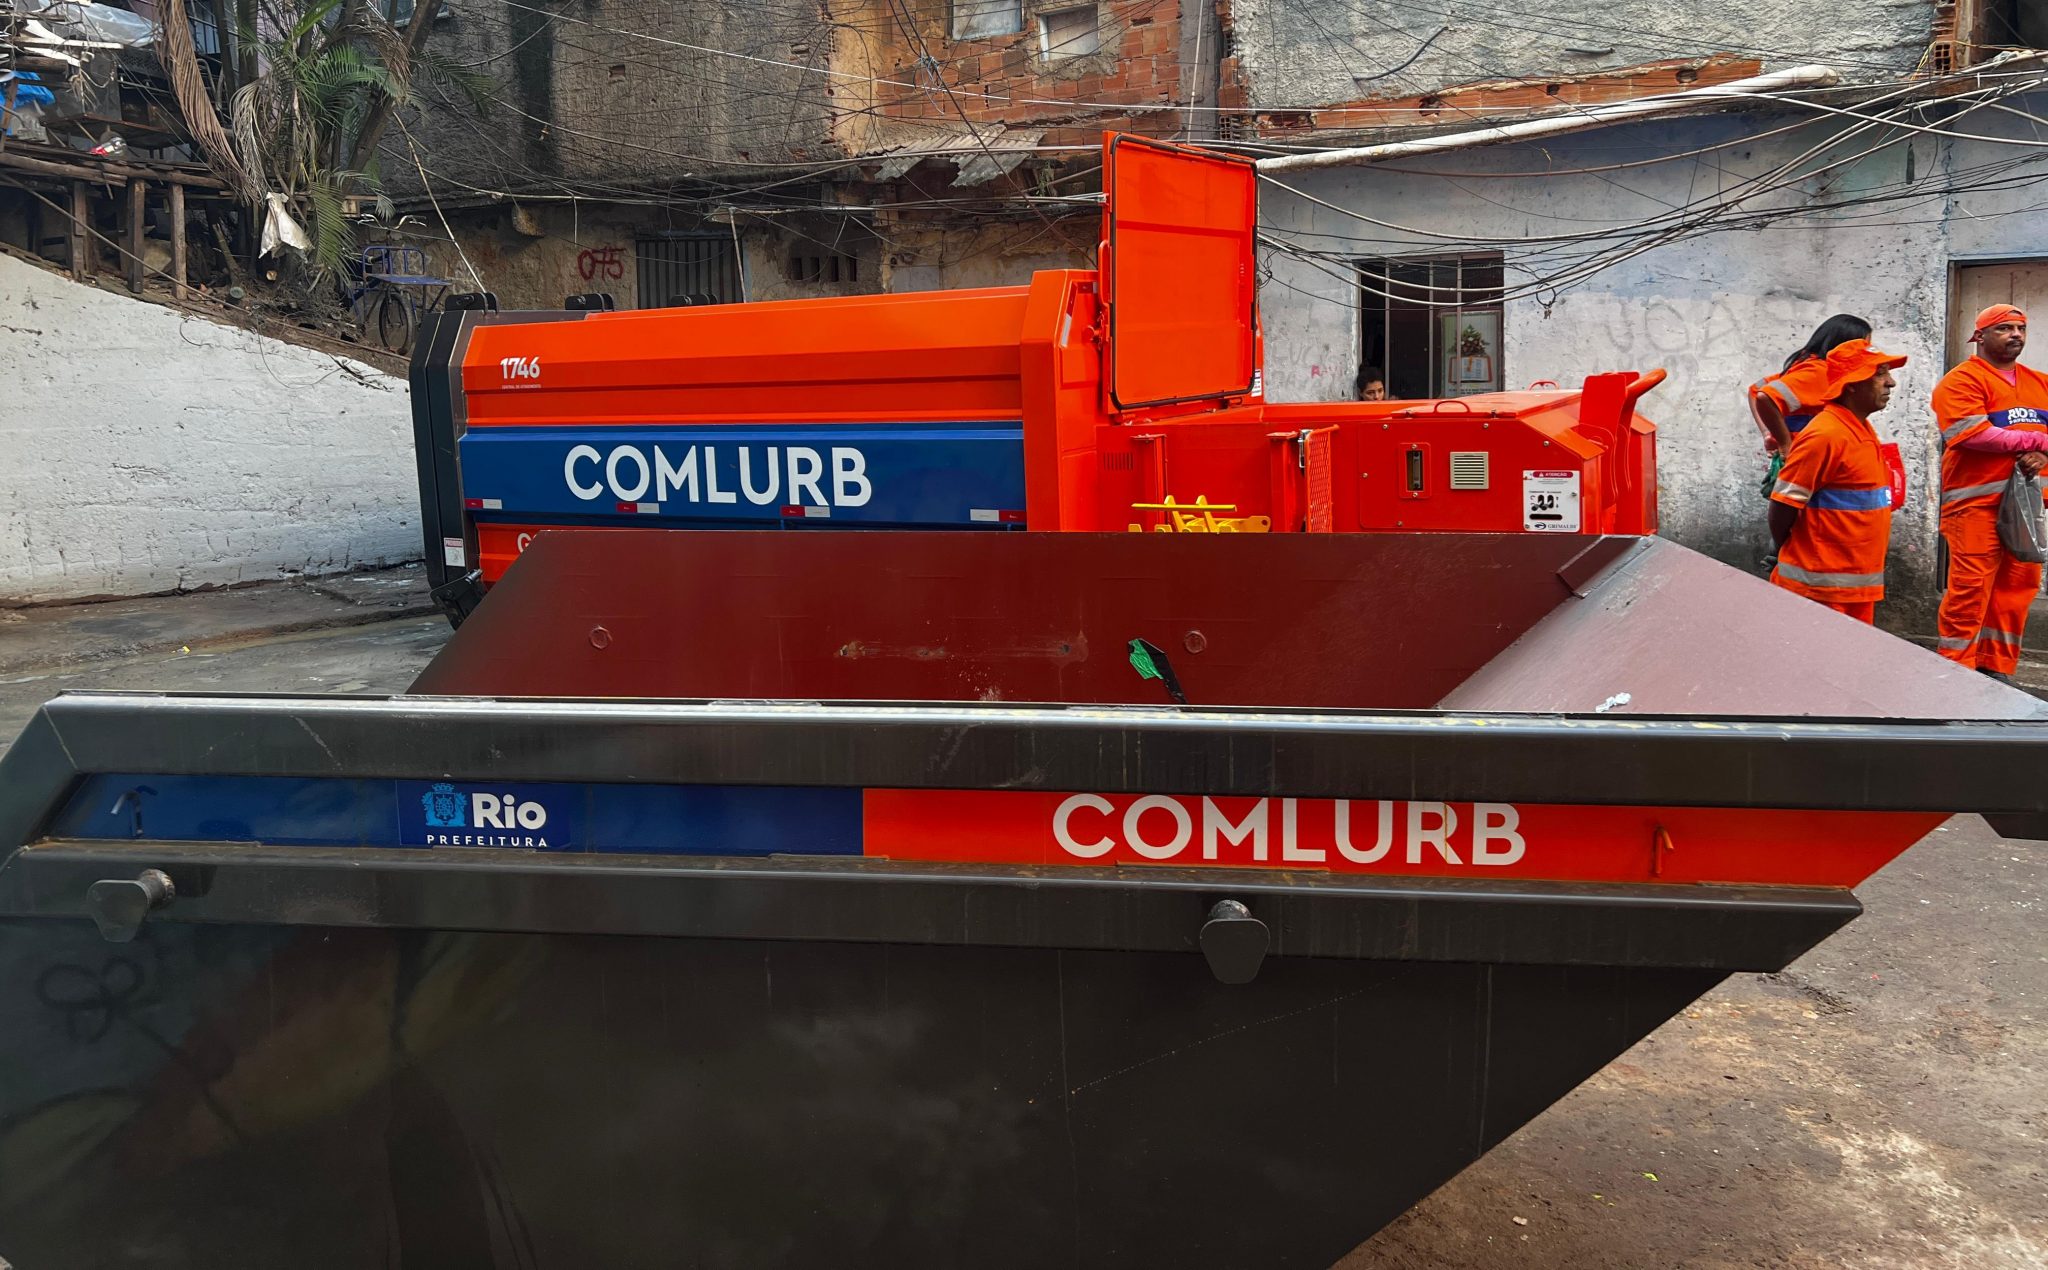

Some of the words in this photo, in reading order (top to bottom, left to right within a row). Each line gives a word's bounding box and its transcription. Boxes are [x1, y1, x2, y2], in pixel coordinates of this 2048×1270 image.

[500, 356, 541, 379] 1746
[564, 444, 872, 507] COMLURB
[472, 793, 546, 830] Rio
[1052, 793, 1526, 866] COMLURB
[426, 835, 547, 847] PREFEITURA
